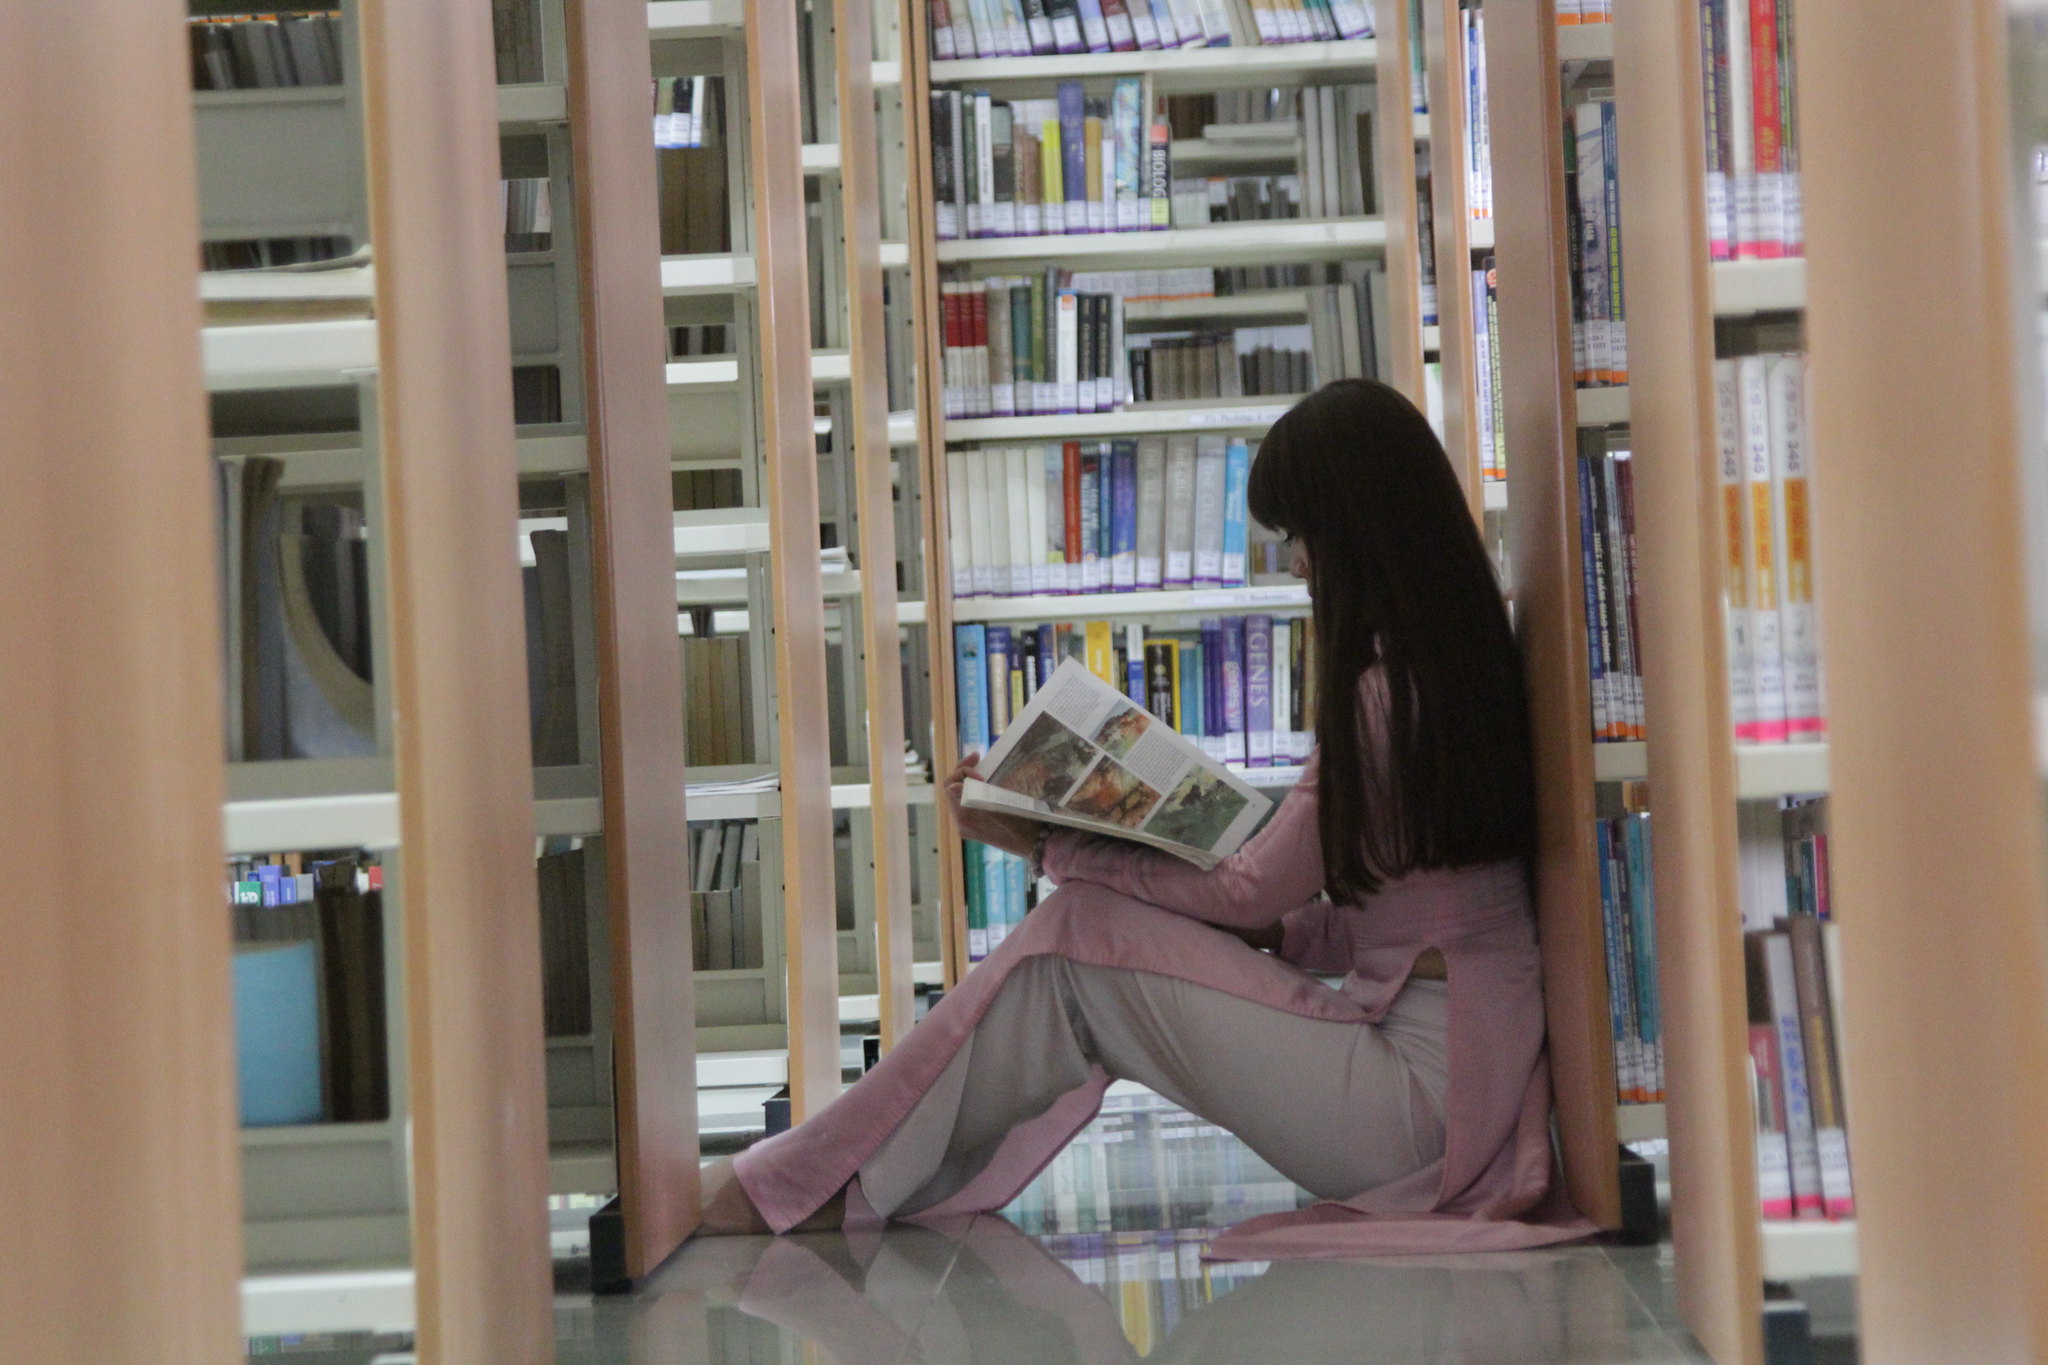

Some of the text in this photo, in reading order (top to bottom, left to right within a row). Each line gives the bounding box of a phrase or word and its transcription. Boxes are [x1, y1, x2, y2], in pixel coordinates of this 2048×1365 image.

[1153, 150, 1168, 198] BIOLOG
[1723, 447, 1736, 478] 345
[1752, 443, 1765, 474] 345
[1787, 440, 1799, 470] 345
[1224, 662, 1240, 708] genes
[1249, 632, 1269, 707] GENES
